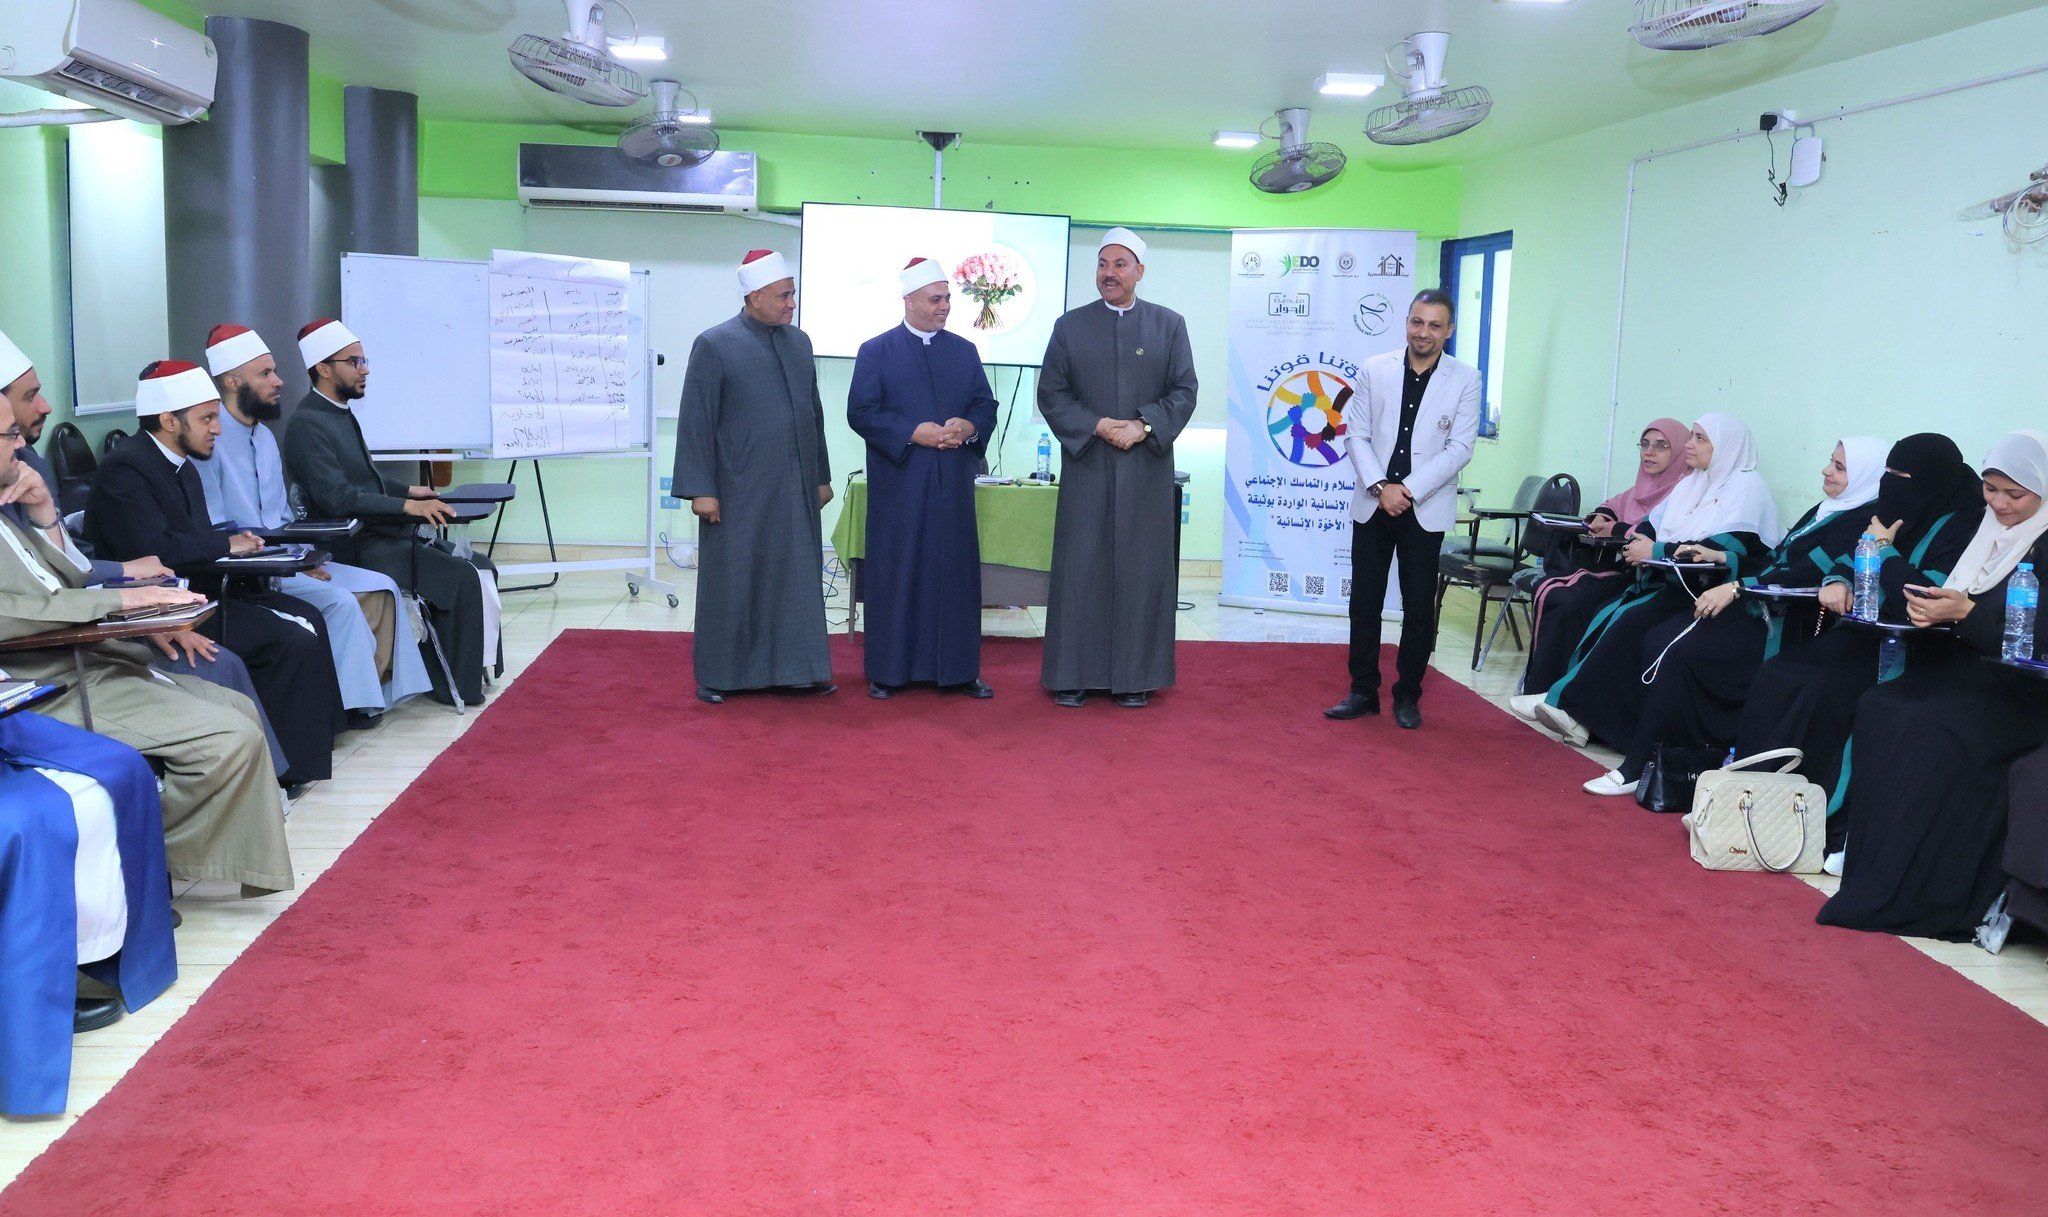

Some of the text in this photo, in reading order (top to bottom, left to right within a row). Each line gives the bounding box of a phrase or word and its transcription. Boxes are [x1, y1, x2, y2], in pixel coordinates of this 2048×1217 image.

[1293, 255, 1320, 268] EDO
[1273, 303, 1305, 314] الحوار
[1257, 354, 1310, 392] قوتنا
[1245, 475, 1356, 491] لسلام والتماسك الإجتماعي
[1248, 494, 1349, 513] الإنسانية الواردة بوثيقة
[1277, 515, 1314, 530] الإنسانية
